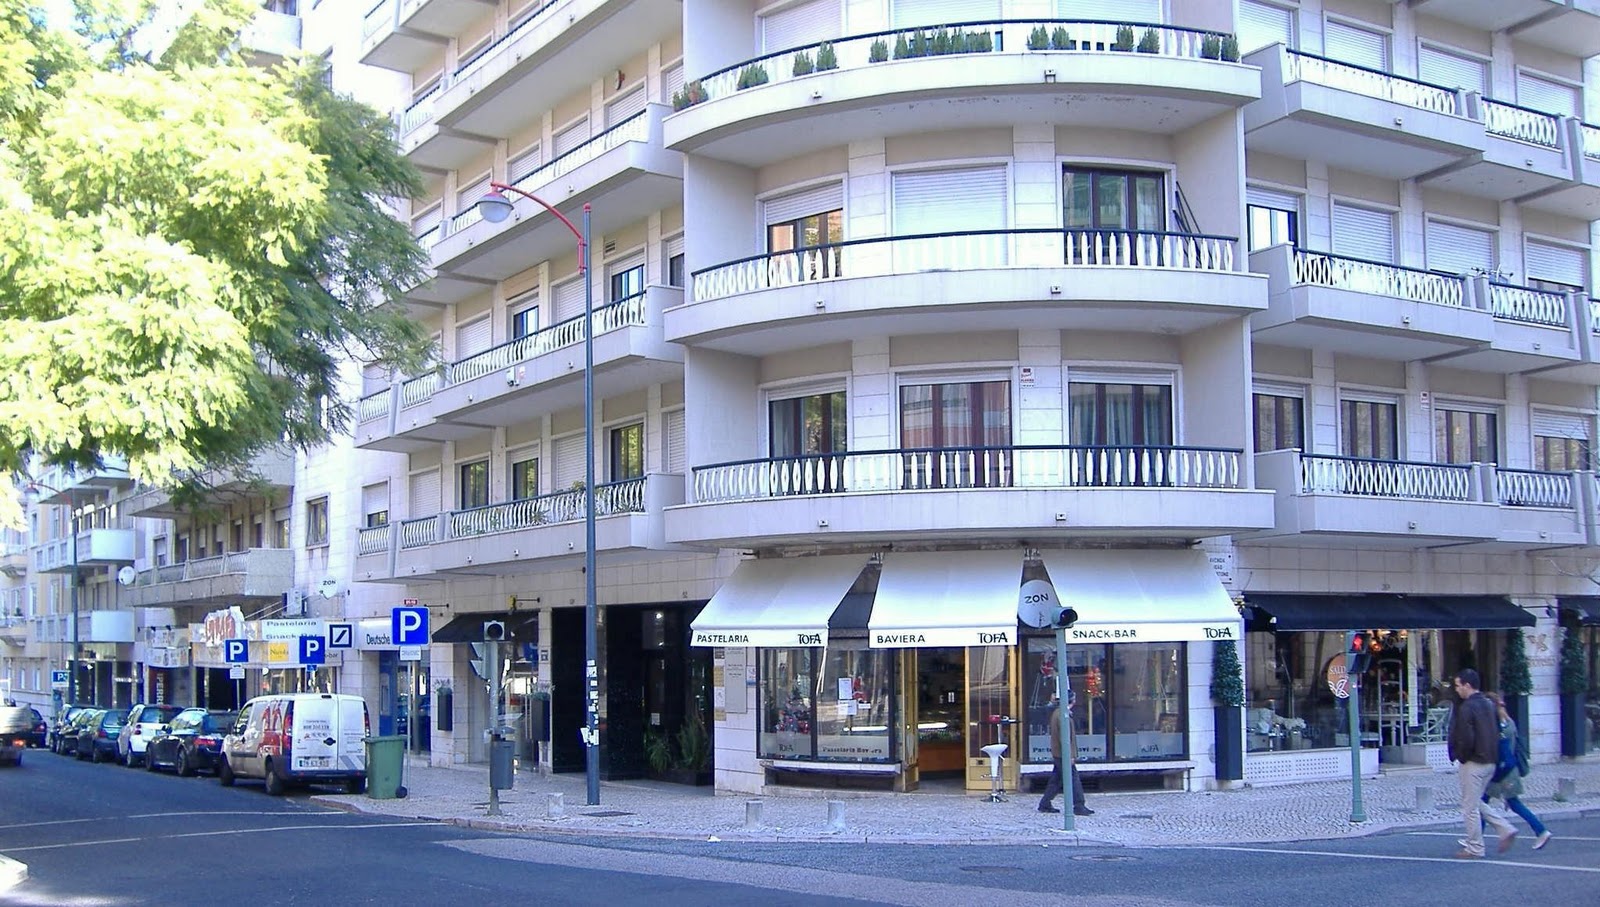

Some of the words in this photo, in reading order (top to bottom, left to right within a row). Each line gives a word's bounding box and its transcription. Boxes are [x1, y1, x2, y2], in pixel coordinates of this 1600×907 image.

[1025, 593, 1049, 604] ZON
[400, 611, 421, 642] P
[366, 633, 391, 645] Deutsche
[697, 635, 749, 643] PASTELARIA
[798, 633, 822, 645] TOFA
[877, 634, 926, 644] BAVIERA
[977, 632, 1008, 644] TOFA
[1203, 627, 1232, 639] TOFA
[230, 642, 244, 661] P
[306, 639, 320, 657] P
